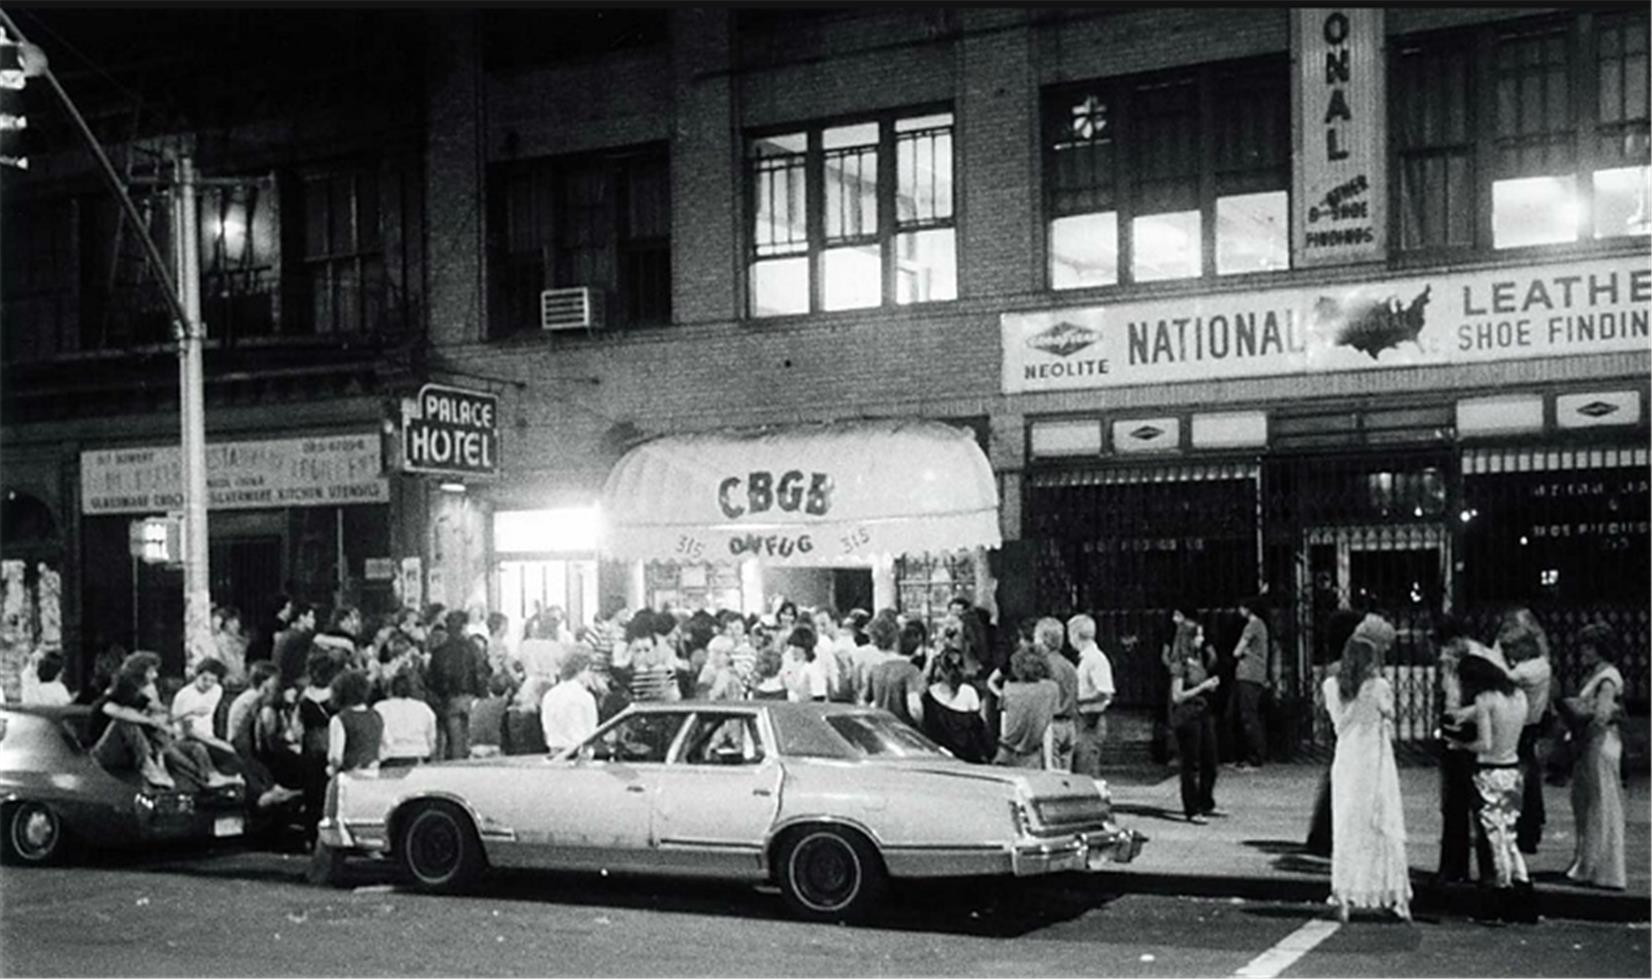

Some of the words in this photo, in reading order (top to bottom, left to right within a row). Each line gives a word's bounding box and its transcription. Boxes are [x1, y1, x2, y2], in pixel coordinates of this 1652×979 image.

[1128, 309, 1305, 365] NATIONAL
[1457, 319, 1532, 351] SHOE
[1025, 358, 1109, 379] NEOLITE
[425, 394, 492, 428] PALACE
[412, 426, 492, 468] HOTEL
[718, 470, 834, 519] CBGB
[676, 535, 706, 559] 315
[840, 528, 870, 554] 315
